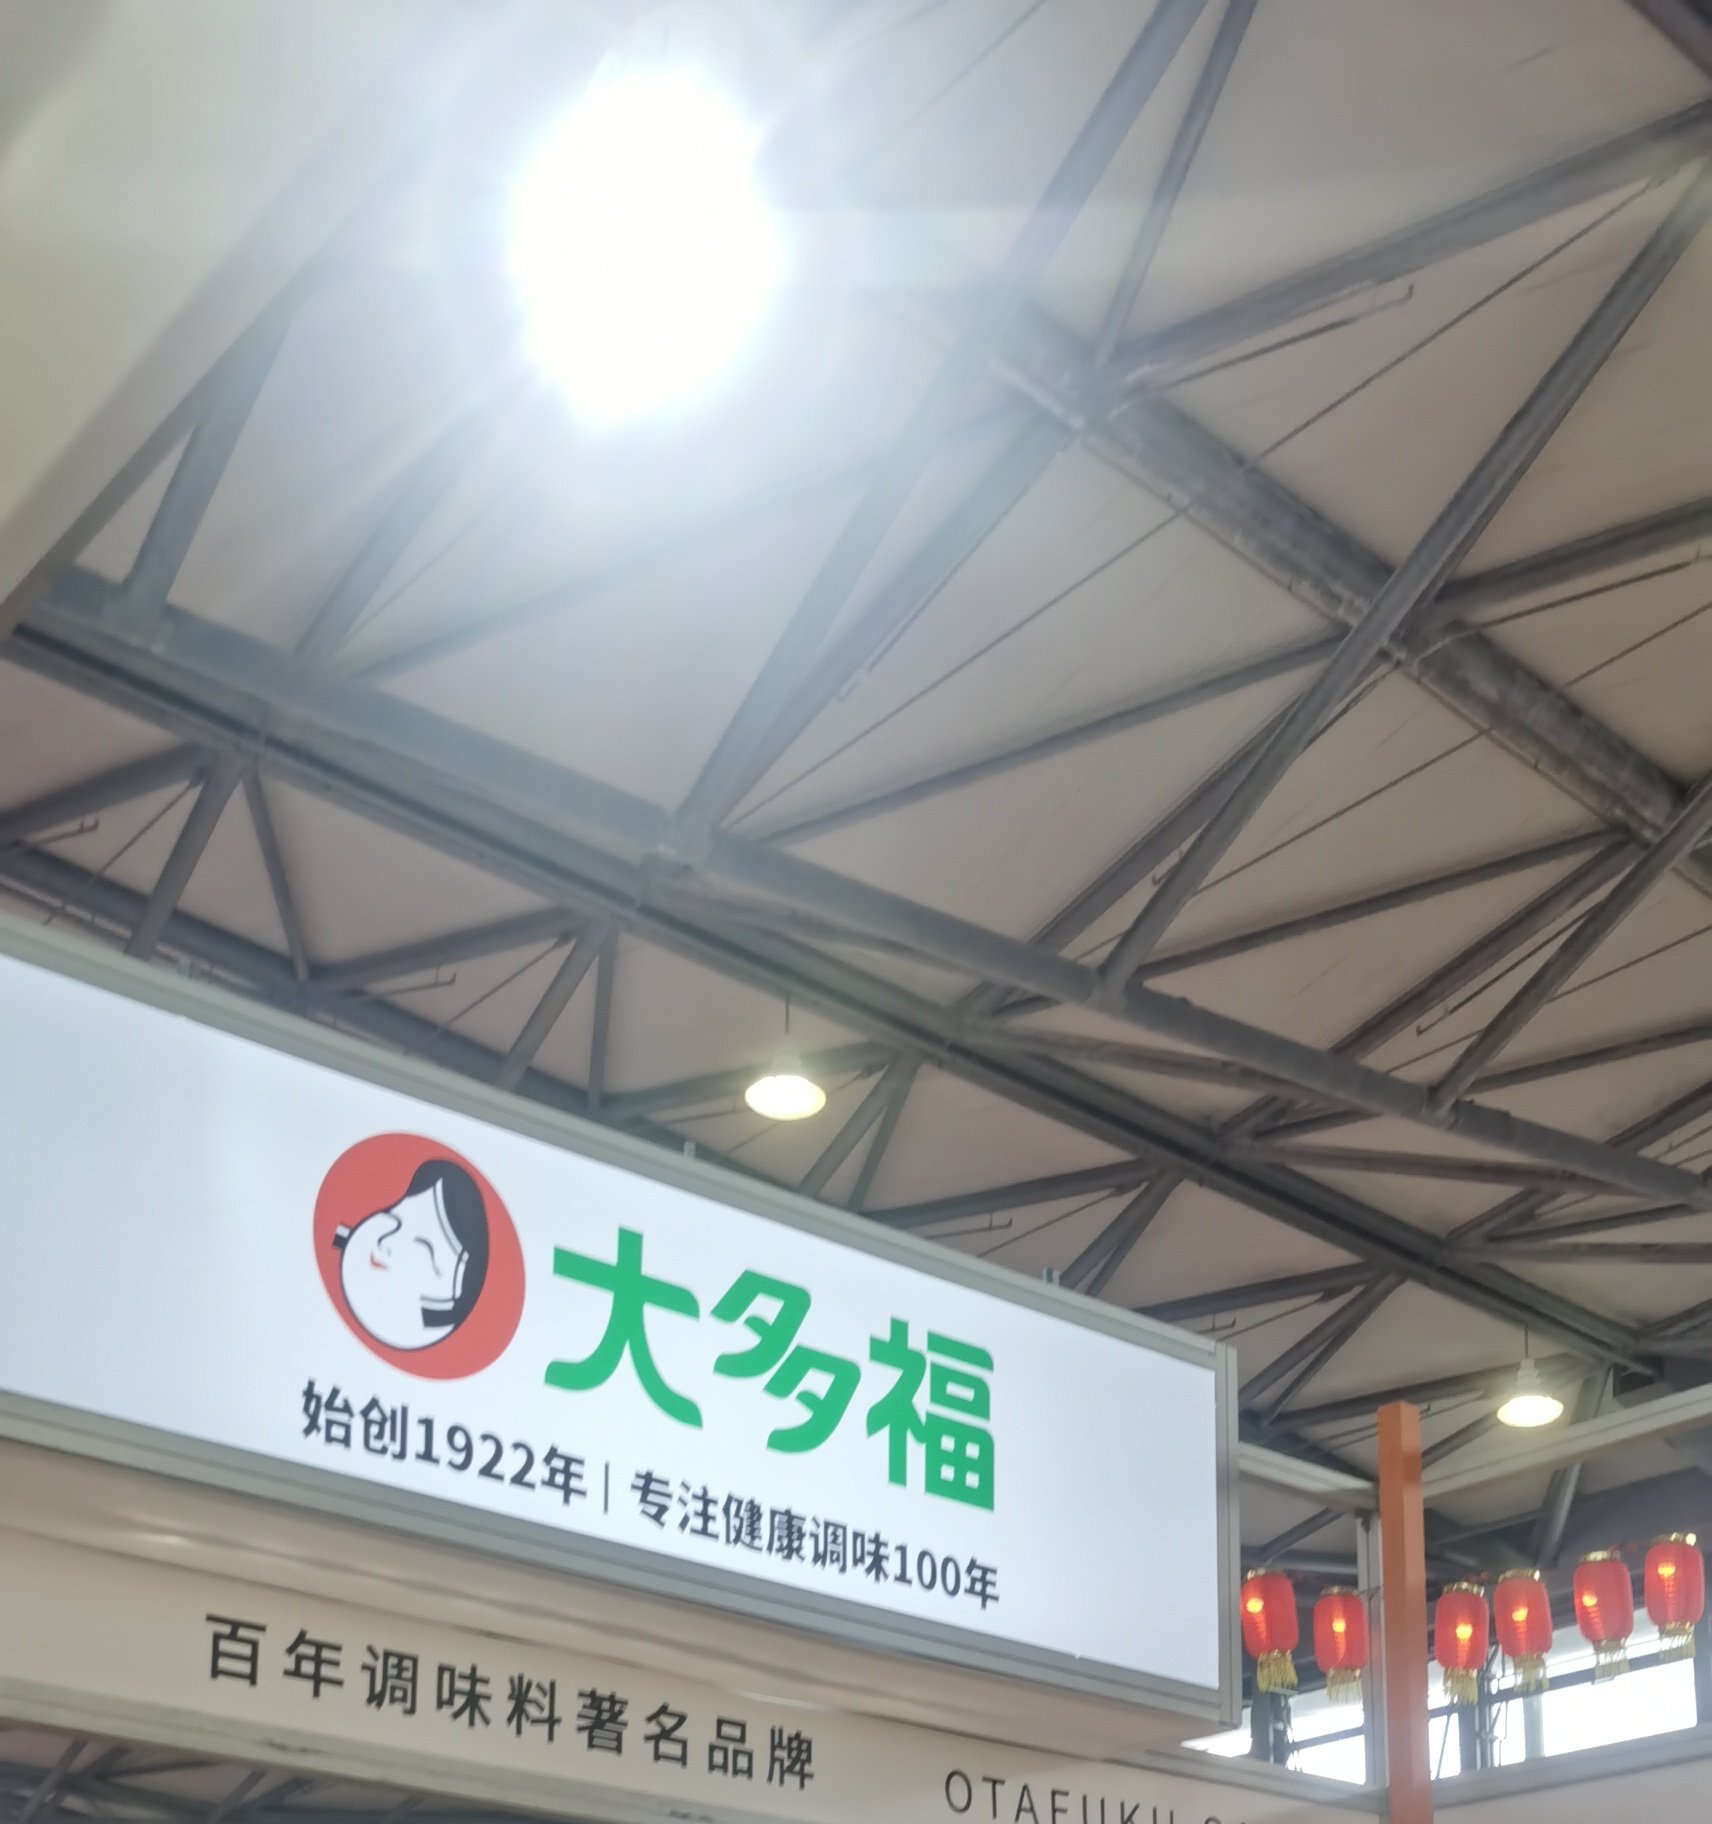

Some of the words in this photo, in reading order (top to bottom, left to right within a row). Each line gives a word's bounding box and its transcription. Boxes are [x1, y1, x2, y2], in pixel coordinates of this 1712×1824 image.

[545, 1225, 996, 1512] 大多福
[302, 1379, 587, 1507] 始创1922年
[629, 1469, 1000, 1611] 专注健康调味100年
[204, 1613, 816, 1790] 百年调味料著名品牌
